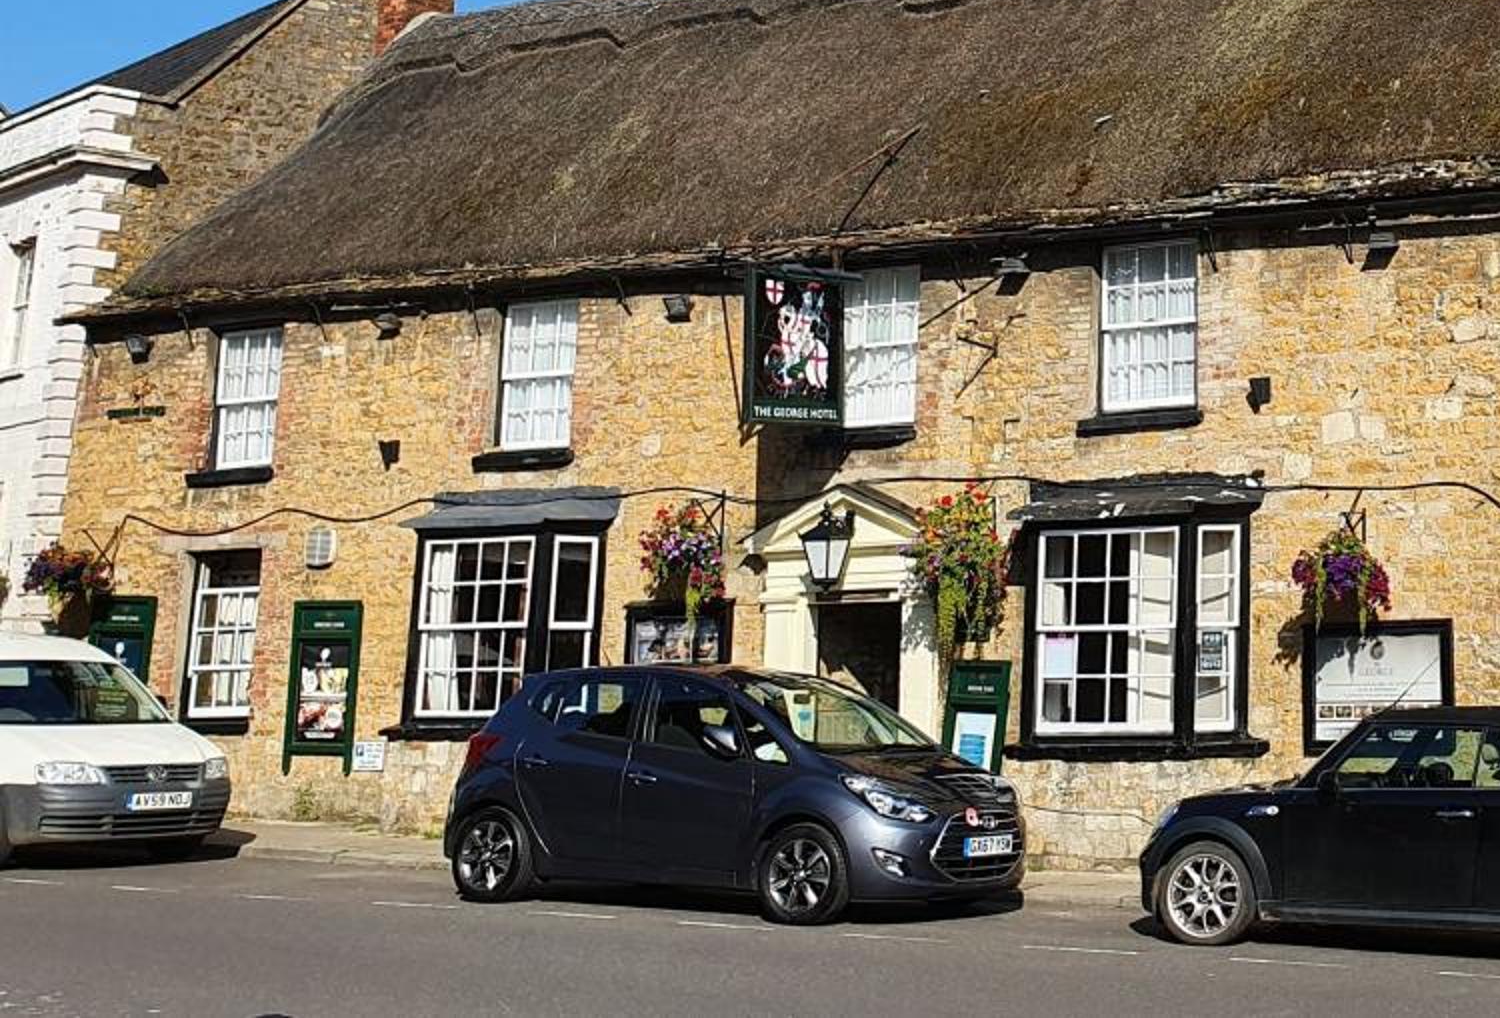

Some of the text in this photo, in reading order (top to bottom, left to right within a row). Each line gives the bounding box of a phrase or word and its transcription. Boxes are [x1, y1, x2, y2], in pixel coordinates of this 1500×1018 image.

[753, 405, 837, 420] THE GEORGE HOTEL
